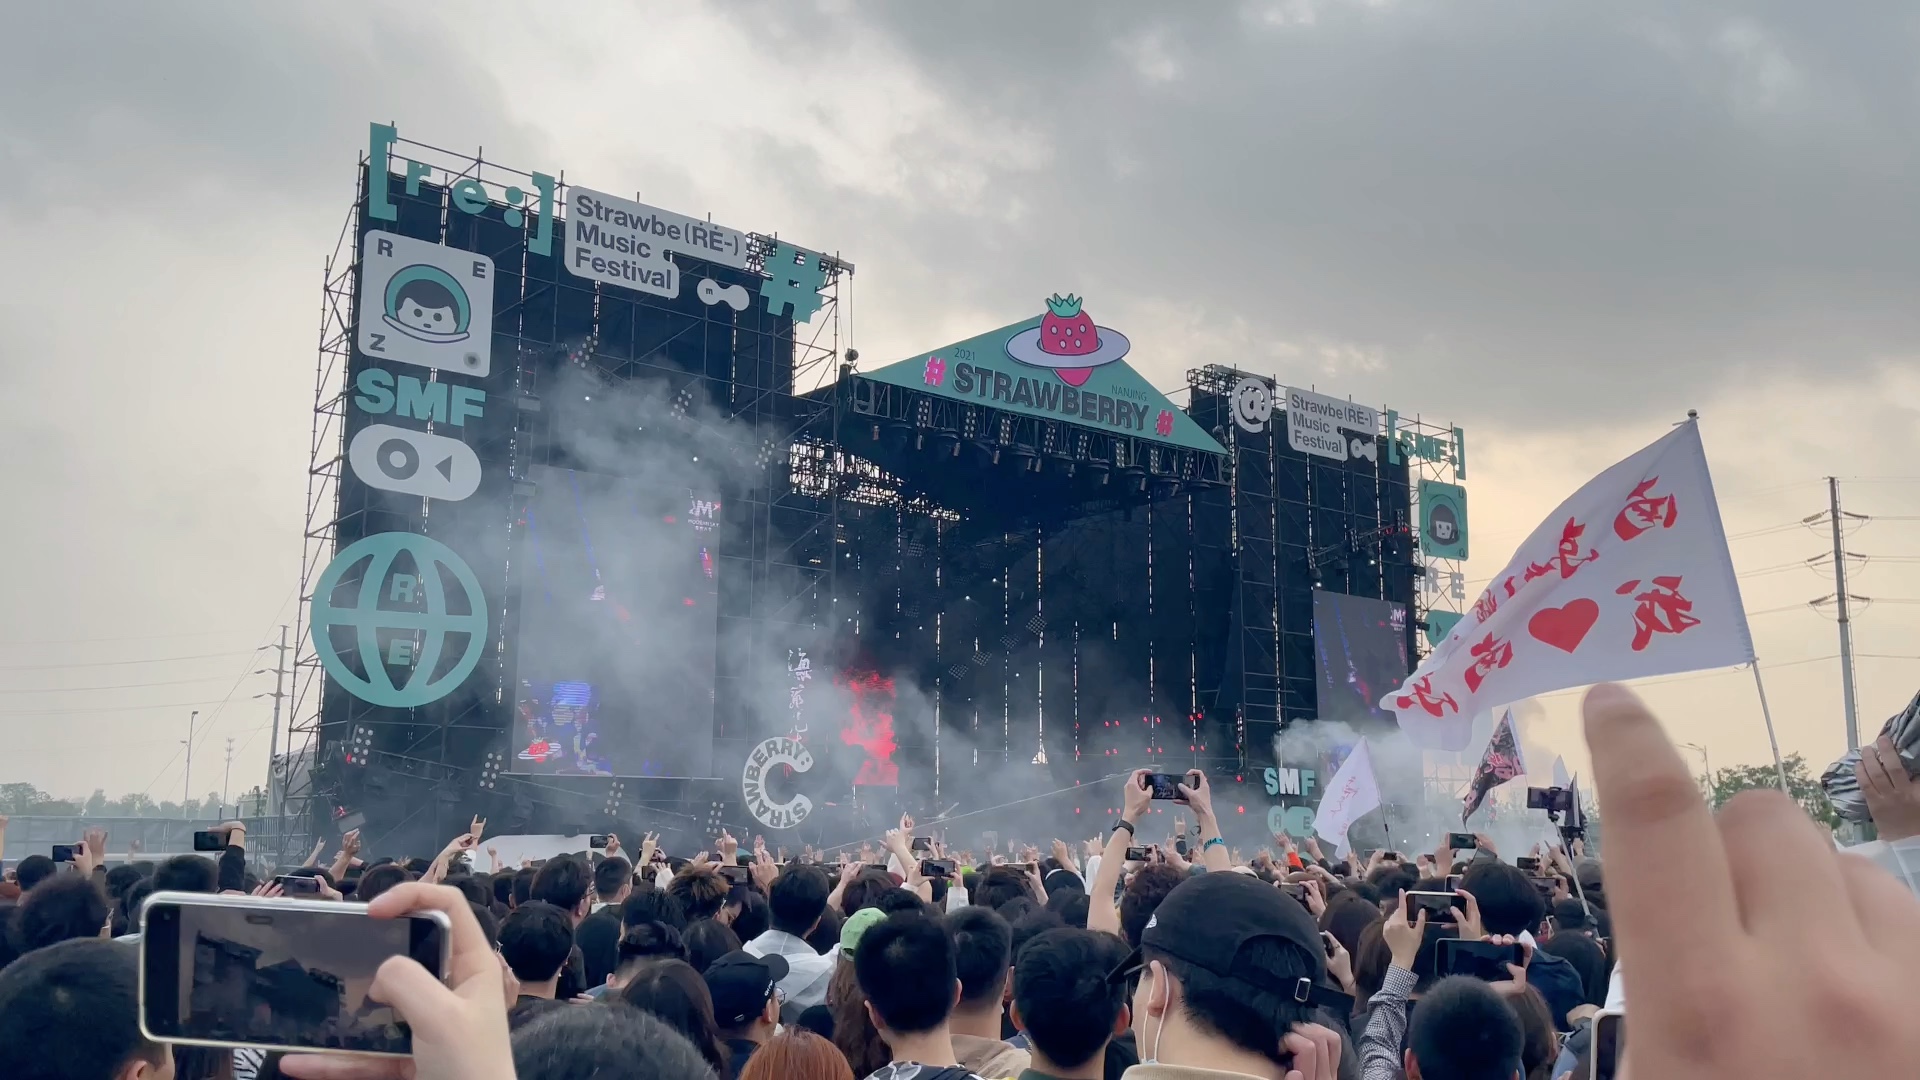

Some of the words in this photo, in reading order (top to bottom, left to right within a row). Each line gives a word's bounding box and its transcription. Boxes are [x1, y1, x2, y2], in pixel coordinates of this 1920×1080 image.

[576, 220, 651, 258] Music
[377, 238, 393, 257] R
[472, 260, 487, 279] E
[575, 247, 672, 290] Festival
[369, 333, 386, 352] Z
[954, 348, 975, 361] 2021
[354, 368, 486, 426] SMF
[953, 362, 1149, 431] STRAWBERRY
[1111, 385, 1147, 402] NANJING
[1292, 411, 1330, 434] Music
[1294, 429, 1342, 455] Festival
[1423, 483, 1429, 492] Y
[1458, 489, 1465, 499] U
[1264, 767, 1316, 796] SMF
